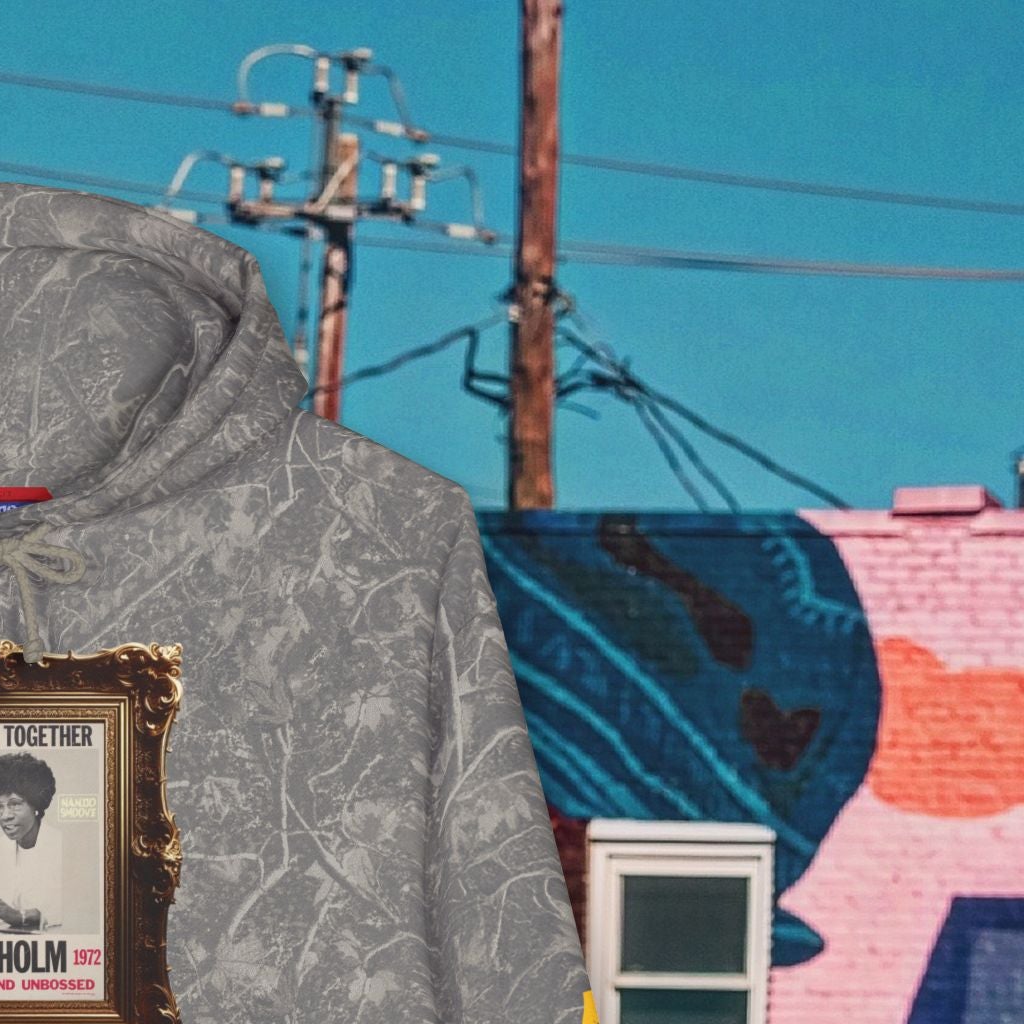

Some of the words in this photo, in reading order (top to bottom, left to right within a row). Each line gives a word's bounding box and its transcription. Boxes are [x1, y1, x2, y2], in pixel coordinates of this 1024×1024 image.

[4, 725, 93, 747] TOGETHER
[73, 949, 102, 966] 1972
[22, 979, 95, 991] UNBOSSED
